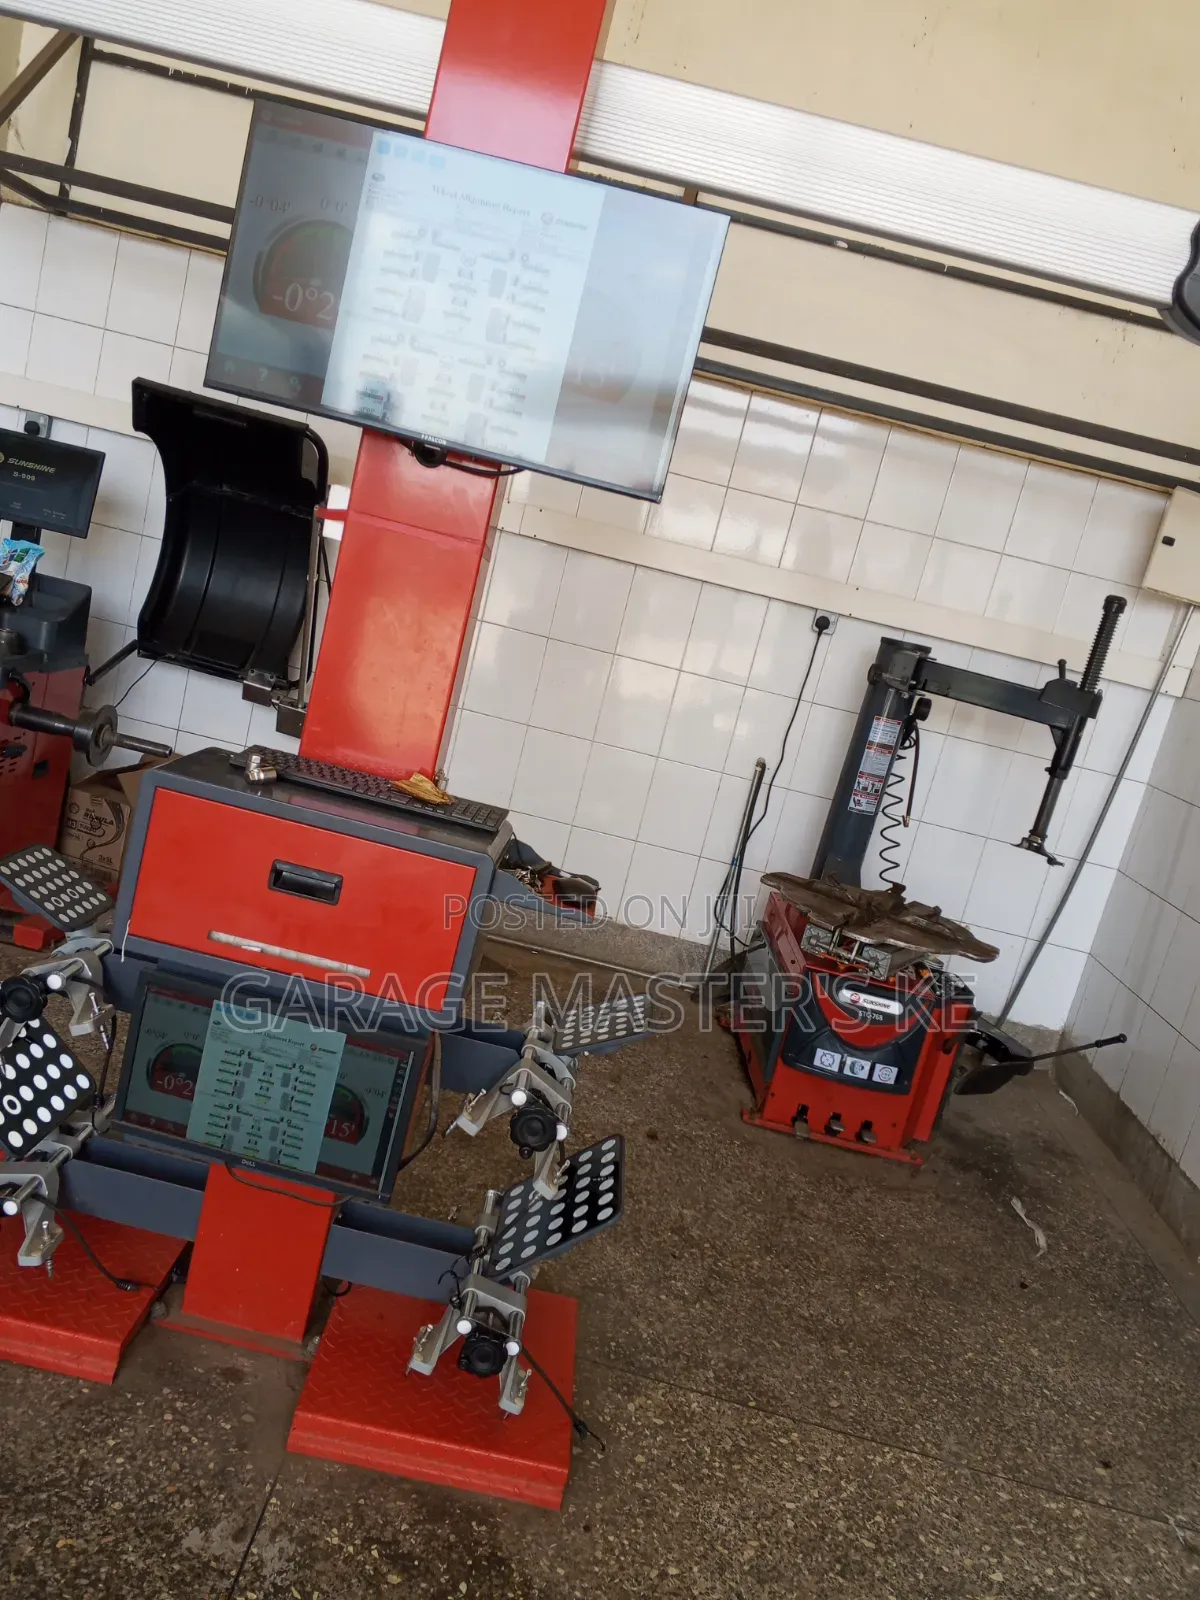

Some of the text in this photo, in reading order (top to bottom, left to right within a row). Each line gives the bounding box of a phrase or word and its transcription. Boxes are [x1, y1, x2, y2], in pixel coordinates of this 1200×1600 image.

[7, 457, 56, 474] SUNSHINE
[863, 998, 892, 1010] SUNSHINE
[241, 1159, 256, 1167] DELL
